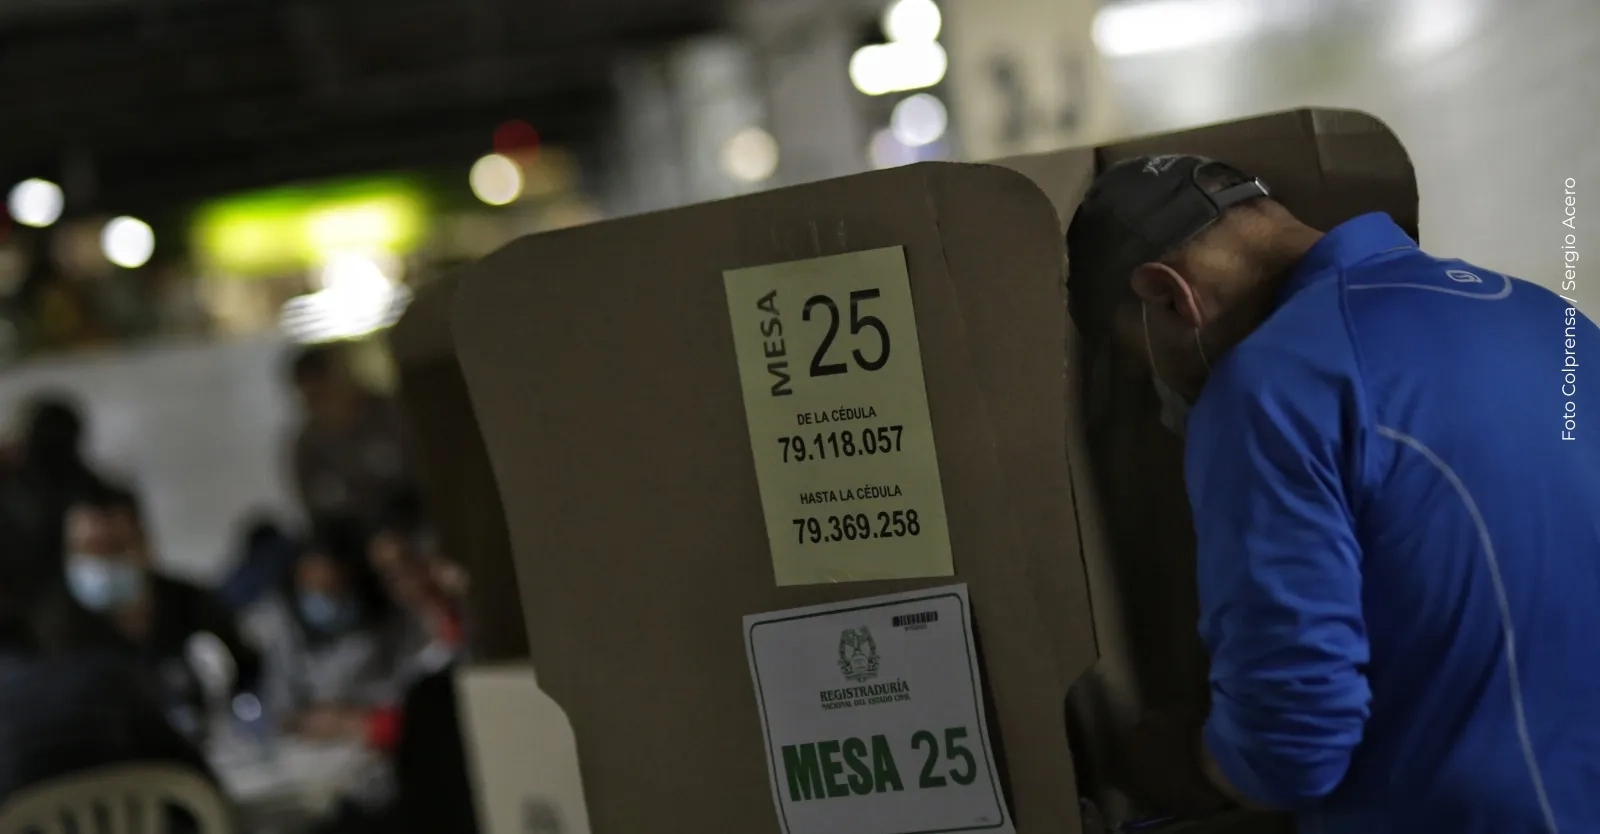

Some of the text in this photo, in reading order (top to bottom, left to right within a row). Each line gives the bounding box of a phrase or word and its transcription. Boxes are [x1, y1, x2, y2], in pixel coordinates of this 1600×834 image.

[756, 289, 793, 397] MESA
[802, 288, 891, 377] 25
[797, 405, 877, 426] DE LA CÉDULA
[778, 425, 904, 463] 79.118.057
[800, 484, 902, 505] HASTA LA CÉDULA
[792, 508, 921, 544] 79.369.258
[819, 678, 910, 702] REGISTRADURÍA
[781, 726, 978, 802] MESA 25
